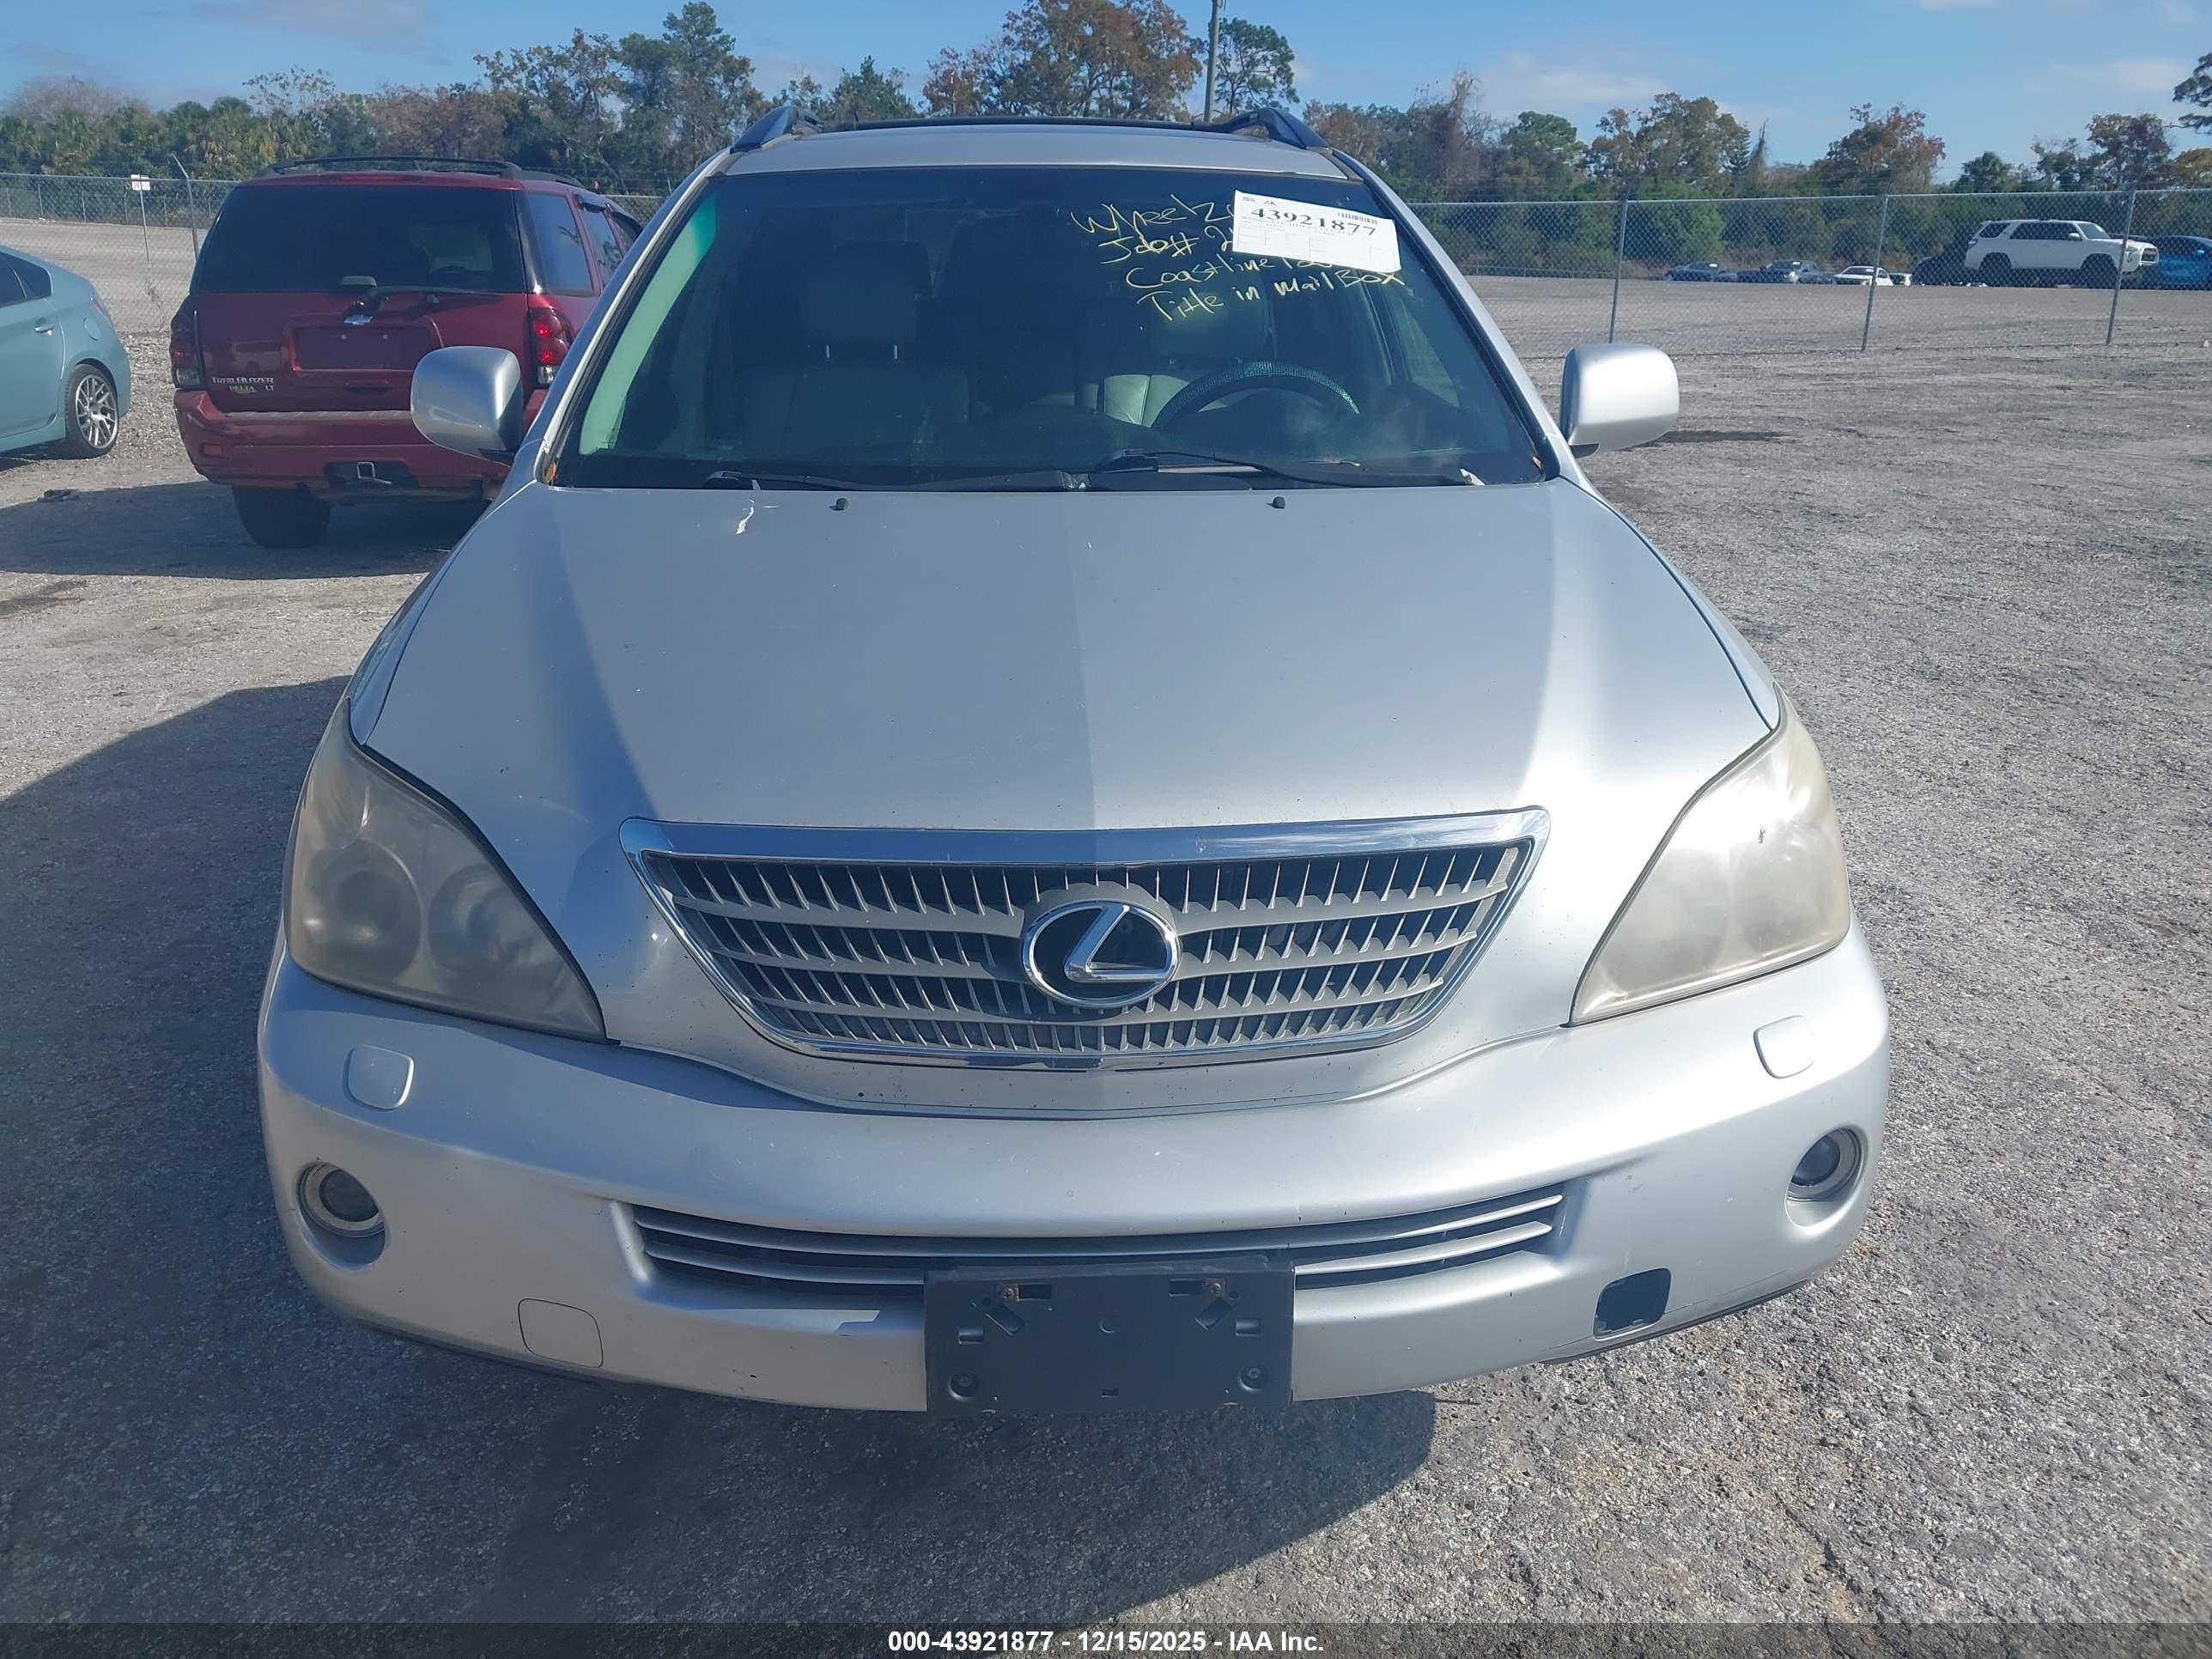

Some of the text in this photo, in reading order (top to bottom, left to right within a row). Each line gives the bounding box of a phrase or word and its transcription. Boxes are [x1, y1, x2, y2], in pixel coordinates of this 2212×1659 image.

[1251, 207, 1376, 236] 43921877
[1126, 253, 1276, 289] Coastline
[1136, 287, 1224, 321] Title
[1231, 286, 1261, 301] in
